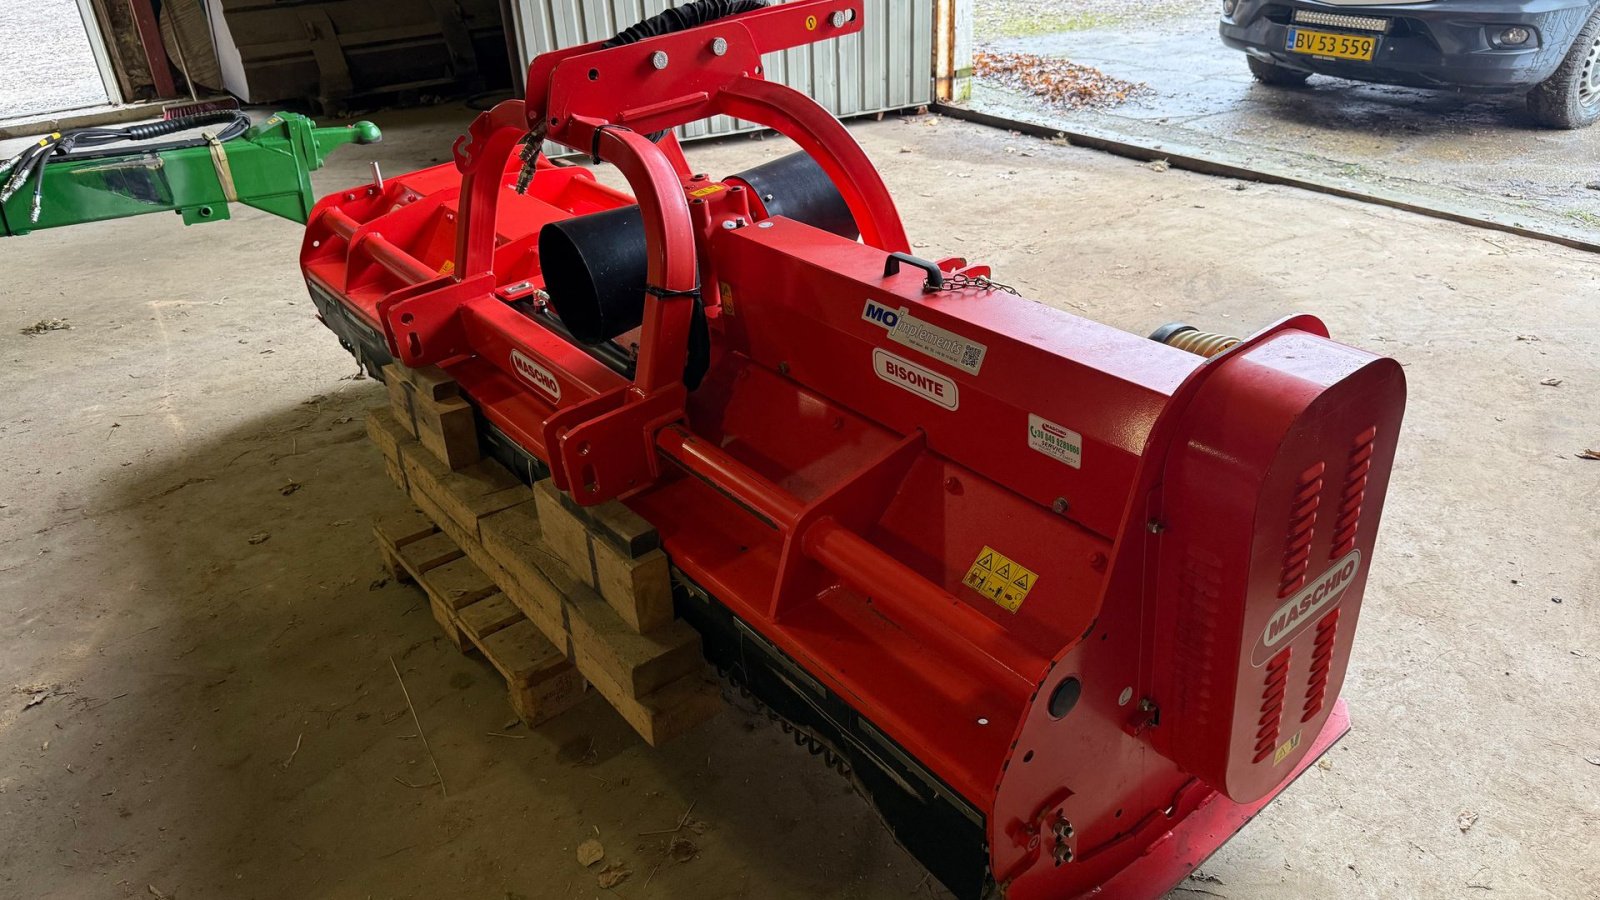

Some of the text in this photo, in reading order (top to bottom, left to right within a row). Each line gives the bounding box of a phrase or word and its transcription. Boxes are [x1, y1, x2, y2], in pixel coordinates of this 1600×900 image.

[1296, 33, 1371, 56] BV 53 559
[514, 355, 557, 393] MASCHIO
[885, 360, 944, 397] BISONTE
[1041, 441, 1065, 454] SERVICE
[1268, 559, 1355, 637] MASCHIO
